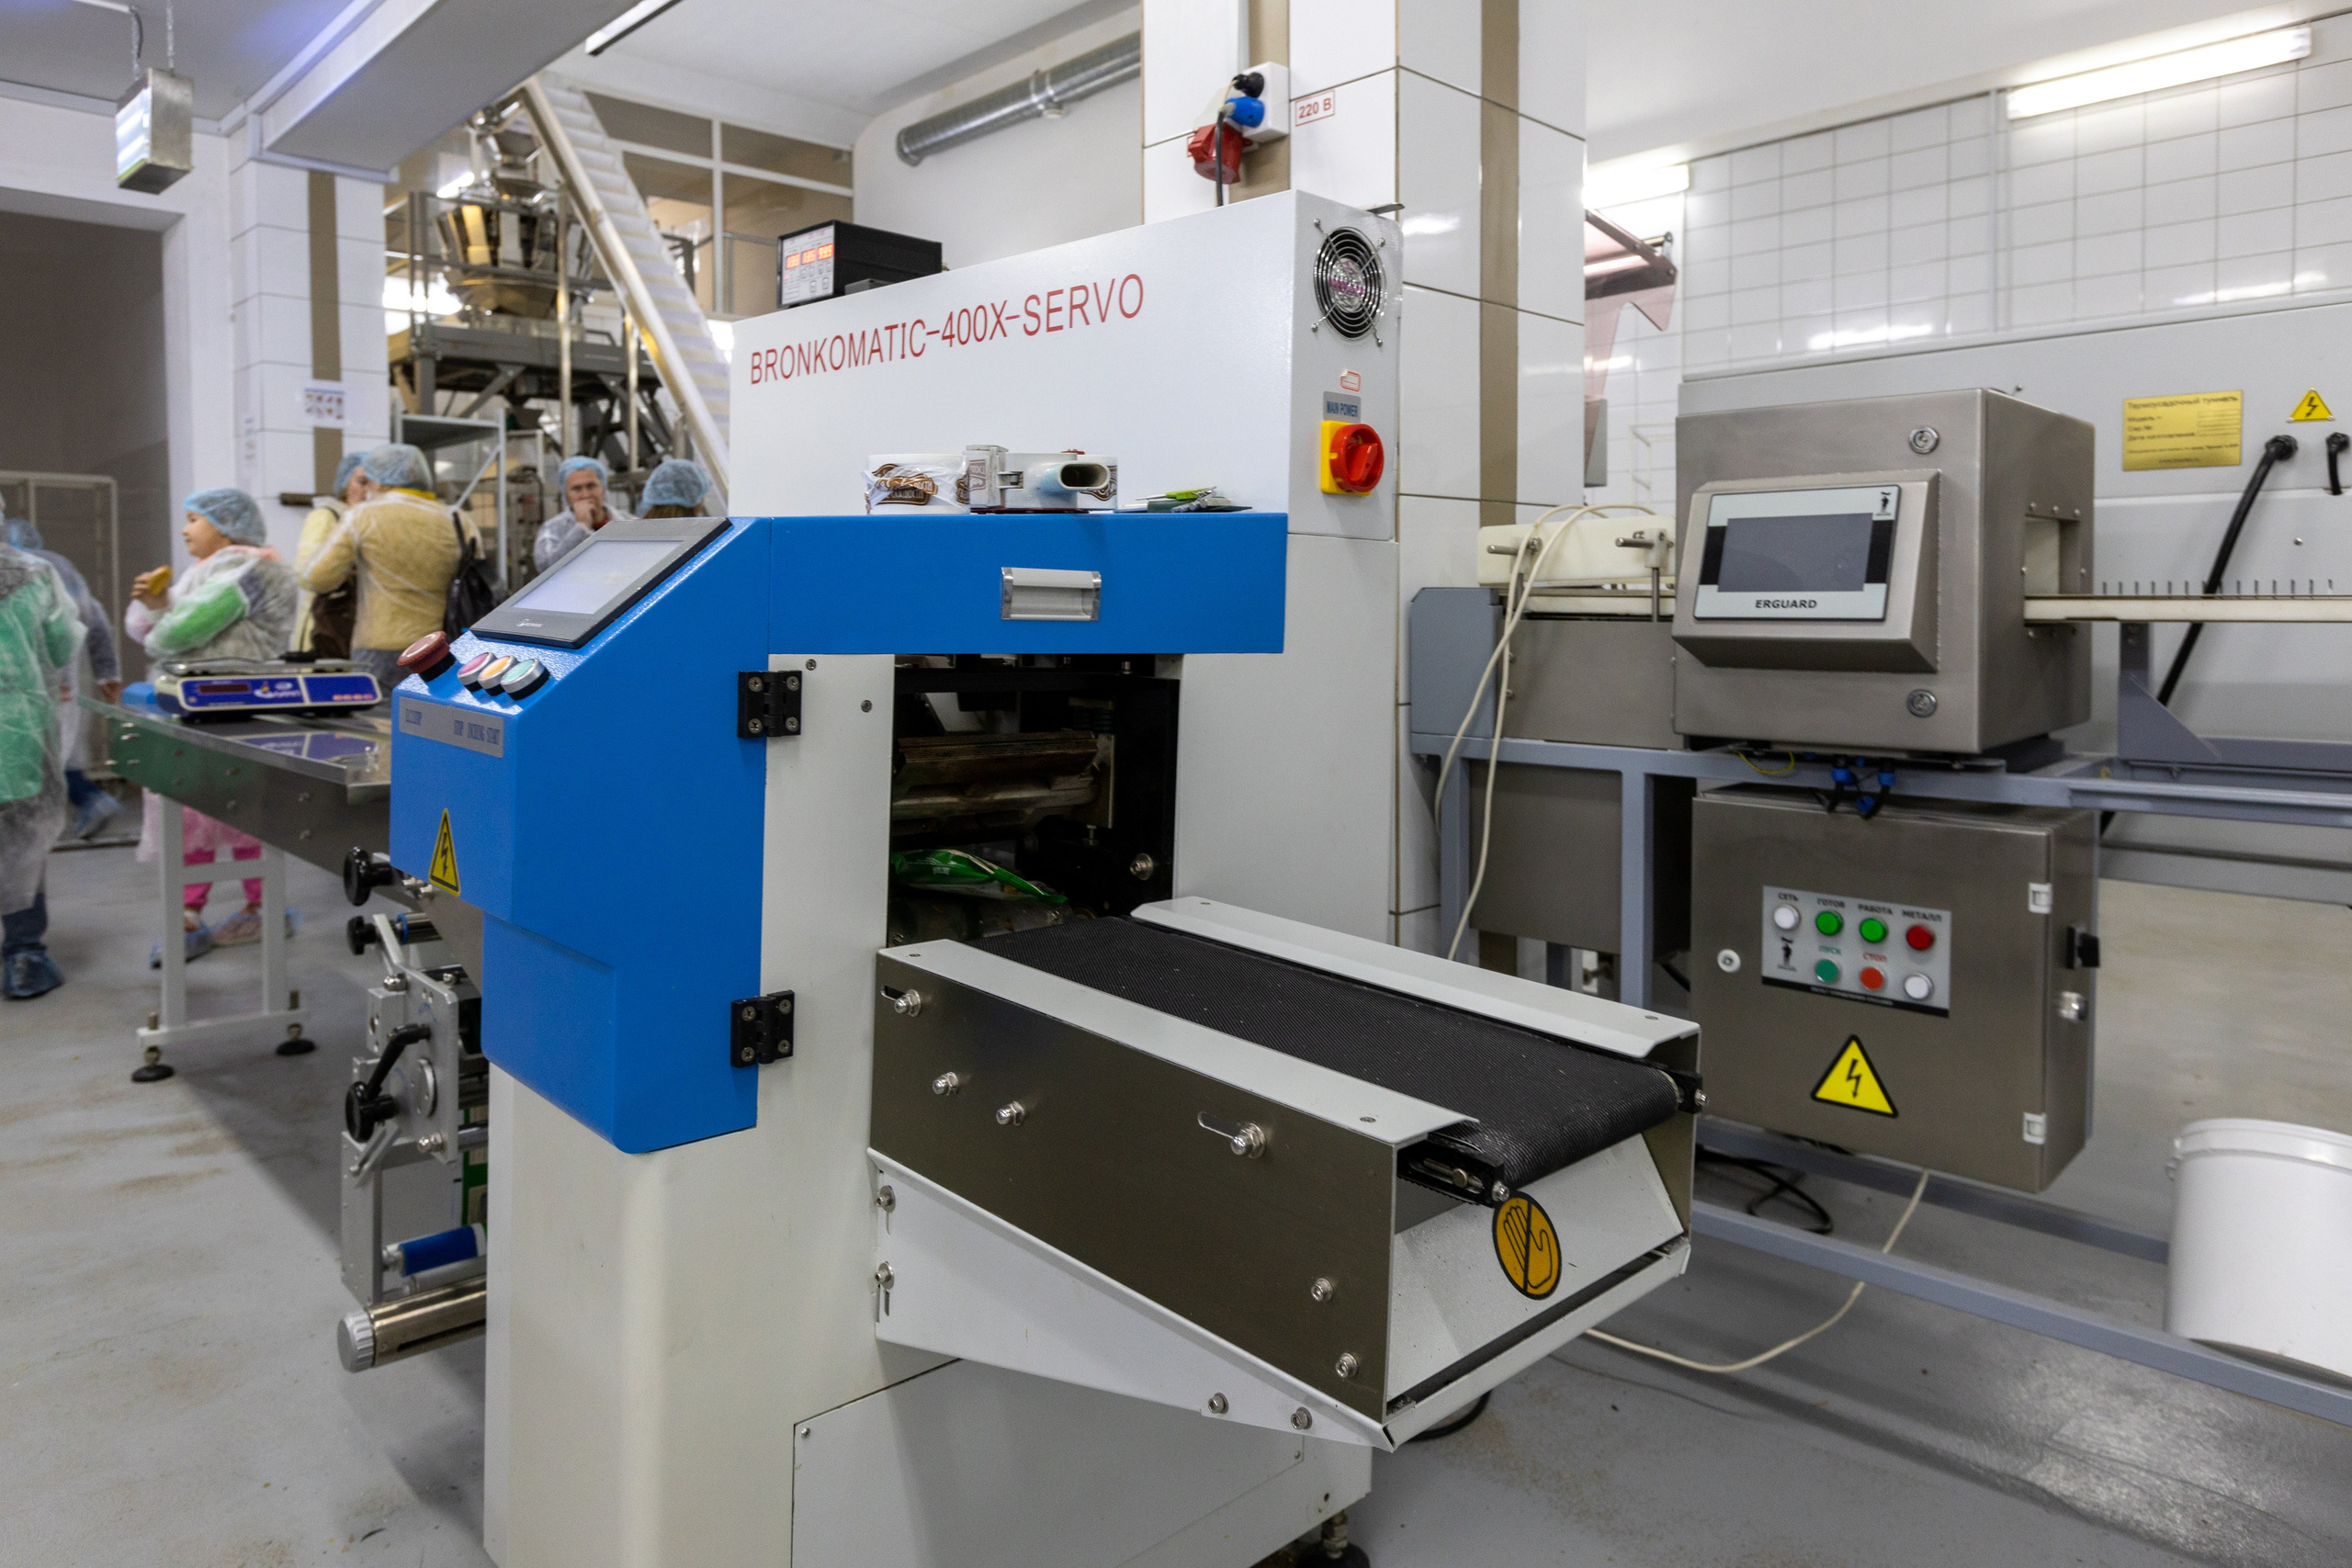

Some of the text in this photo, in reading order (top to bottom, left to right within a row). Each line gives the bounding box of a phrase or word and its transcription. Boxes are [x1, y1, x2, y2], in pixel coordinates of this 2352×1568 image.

[1299, 102, 1319, 118] 220
[751, 274, 1145, 385] BRONKOMATIC-400X-SERVO
[1326, 400, 1358, 417] MAIN POWER
[1756, 599, 1817, 609] ERGUARD
[1778, 892, 1799, 901] СЕТЬ
[1817, 897, 1846, 908] ГОТОВ
[1858, 903, 1893, 916] РАБОТА
[1902, 908, 1943, 923] МЕТАЛЛ
[1818, 944, 1842, 956] ПУСК
[1862, 952, 1888, 963] СТОП
